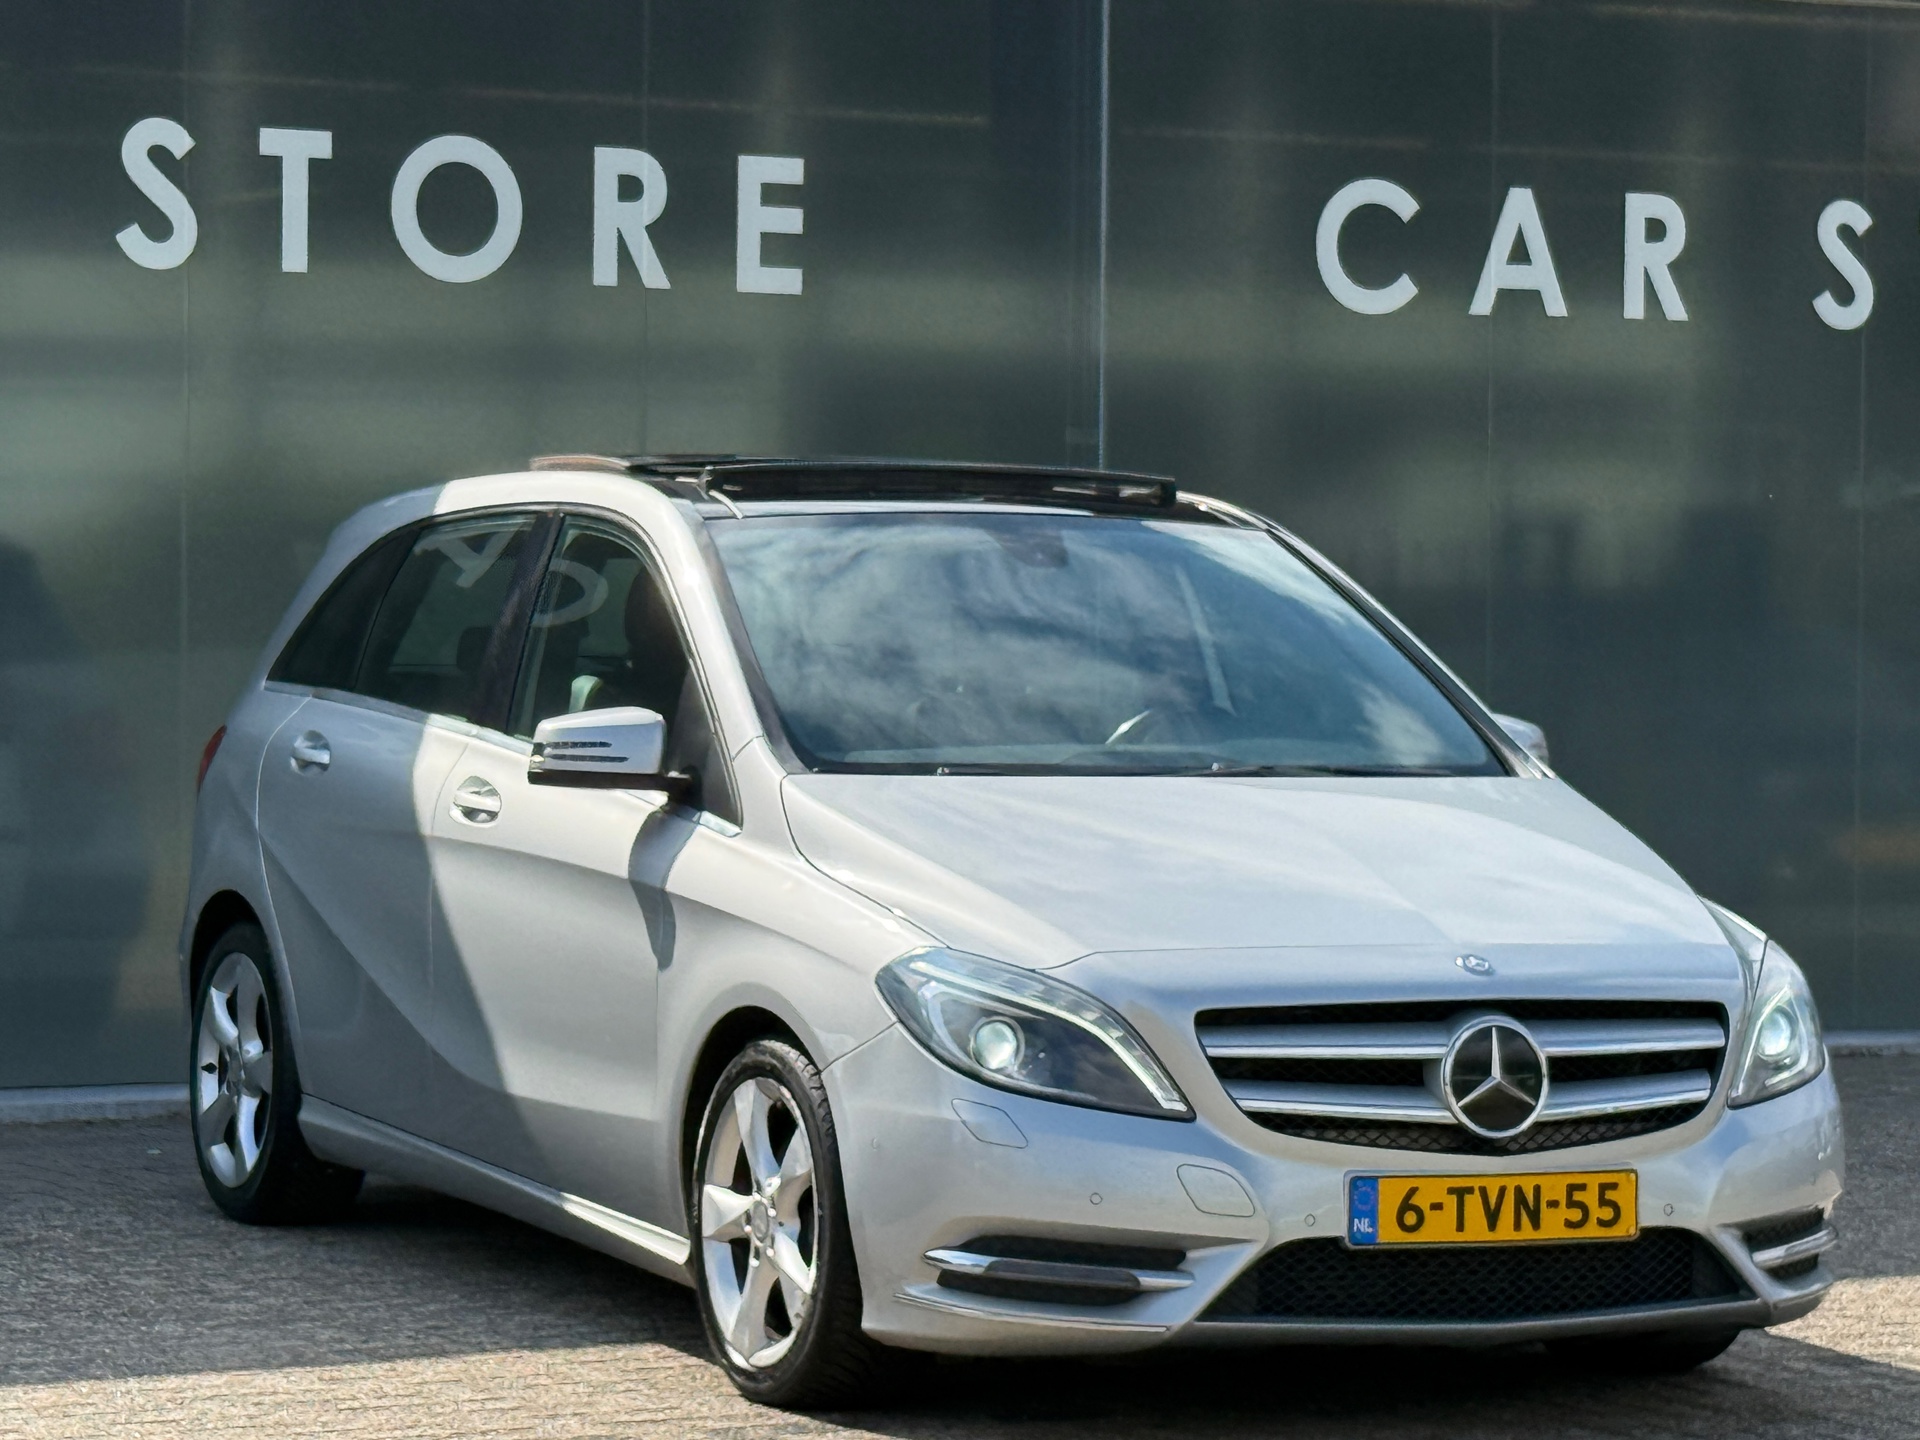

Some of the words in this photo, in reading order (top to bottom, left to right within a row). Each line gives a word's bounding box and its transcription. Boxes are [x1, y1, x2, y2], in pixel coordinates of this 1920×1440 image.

[115, 117, 805, 295] STORE
[1316, 178, 1689, 322] CAR
[1353, 1217, 1374, 1233] NL
[1395, 1181, 1622, 1234] 6-TVN-55
